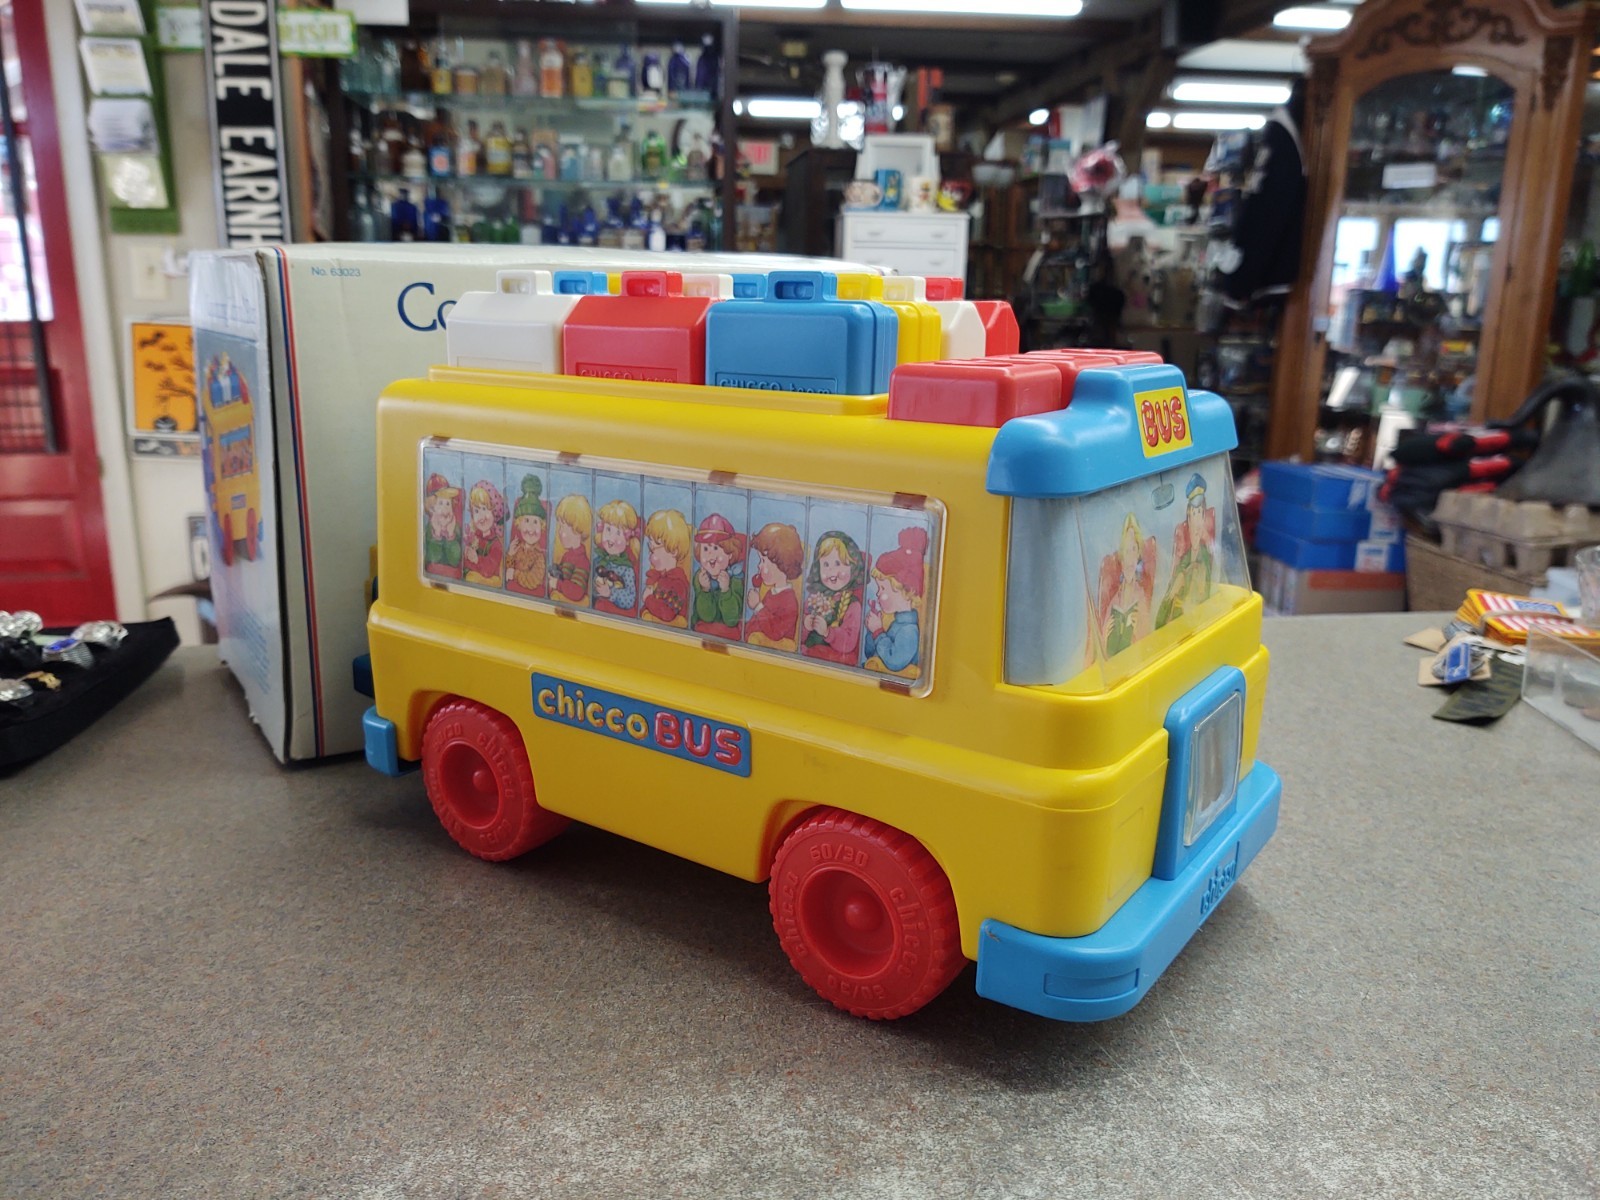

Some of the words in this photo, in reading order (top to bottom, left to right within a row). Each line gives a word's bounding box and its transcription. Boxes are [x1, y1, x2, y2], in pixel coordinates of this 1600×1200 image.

[210, 0, 273, 101] DALE
[279, 23, 339, 41] RISH
[219, 126, 284, 249] EARNH
[311, 266, 327, 277] No.
[330, 267, 361, 277] 63023
[1140, 395, 1186, 448] BUS
[538, 683, 649, 740] chicco
[654, 711, 743, 767] BUS
[889, 886, 926, 979] chicco
